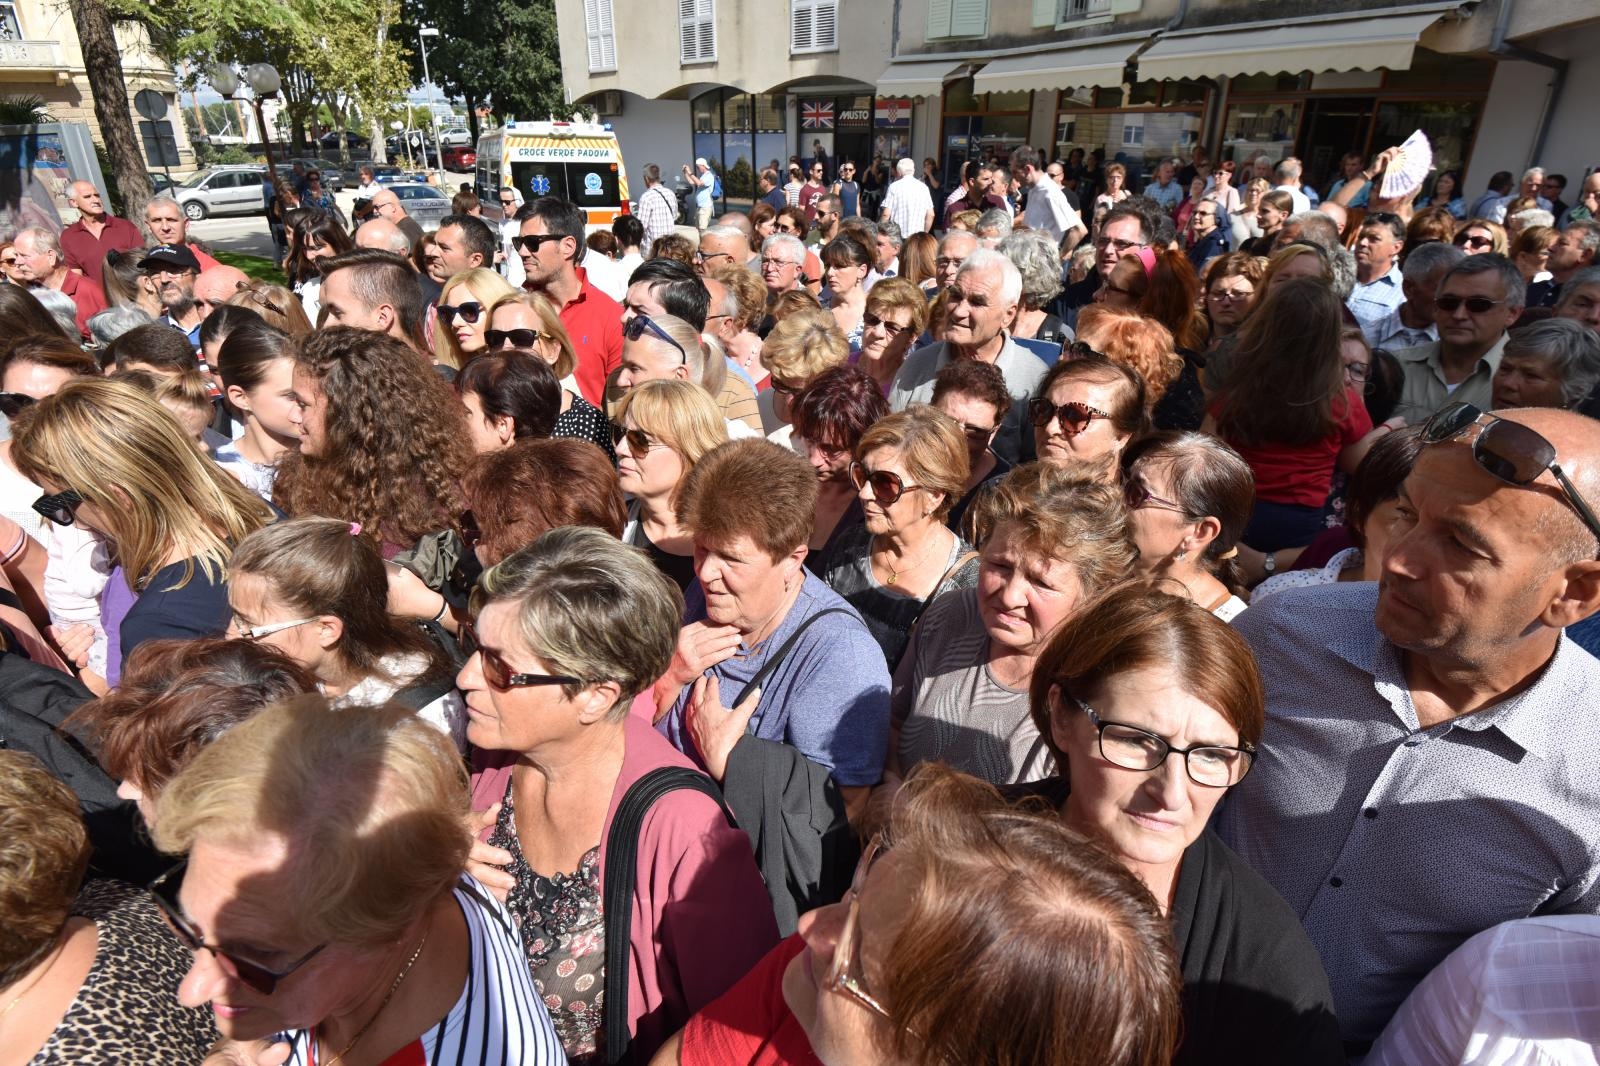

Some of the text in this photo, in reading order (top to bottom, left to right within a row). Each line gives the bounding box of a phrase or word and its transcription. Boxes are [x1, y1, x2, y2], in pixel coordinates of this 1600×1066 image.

[839, 110, 869, 120] MUSTO
[518, 148, 610, 158] CROCE VERDE PADOVA
